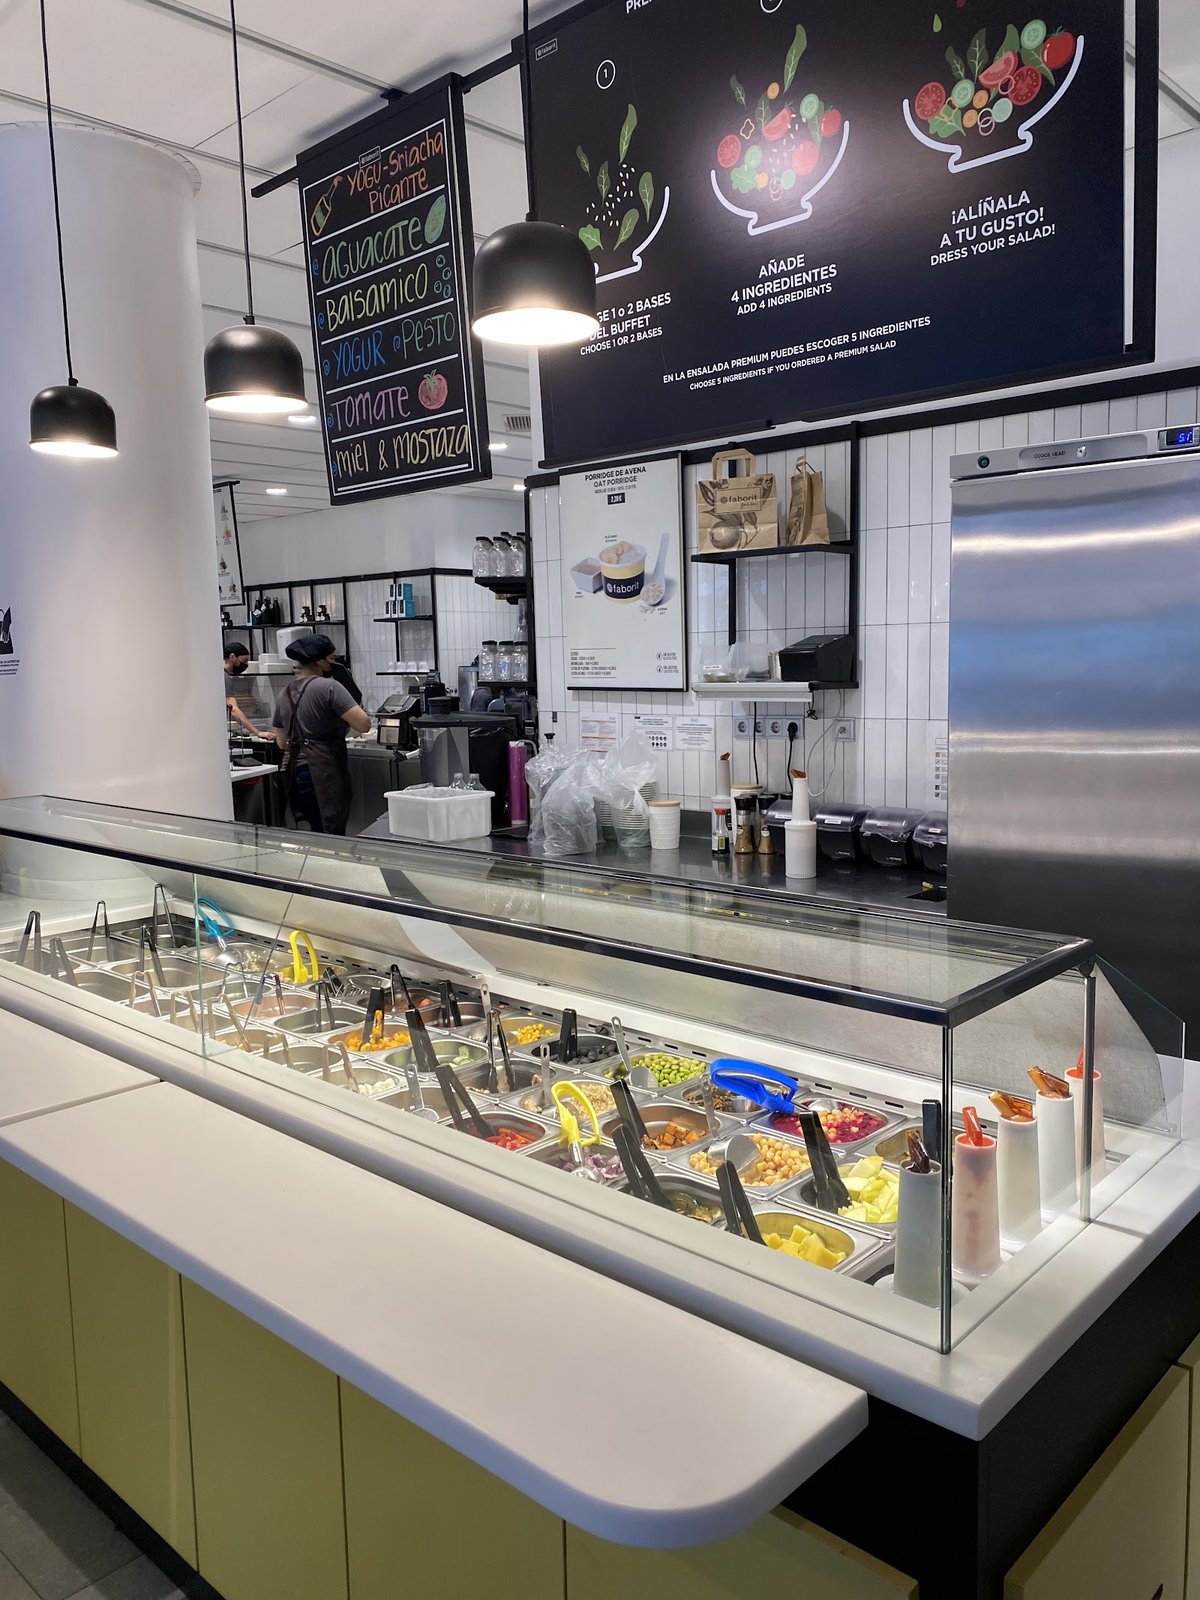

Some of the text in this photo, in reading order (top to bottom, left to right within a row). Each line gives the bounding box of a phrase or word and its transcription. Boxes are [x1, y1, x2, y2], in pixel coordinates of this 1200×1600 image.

[603, 68, 608, 78] 1
[951, 190, 1031, 225] ¡ALÍÑALA
[939, 206, 1044, 248] A TU GUSTO!
[930, 223, 1056, 266] DRESS YOUR SALAD!
[758, 253, 805, 278] AÑADE
[730, 264, 837, 303] 4 INGREDIENTES
[611, 307, 616, 319] 1
[627, 303, 634, 315] 2
[636, 292, 672, 312] BASES
[736, 282, 833, 316] ADD 4 INGREDIENTS
[610, 314, 651, 336] BUFFET
[332, 331, 386, 380] YOGUR
[580, 326, 663, 355] CHOOSE 1 OR 2 BASES
[663, 316, 931, 384] EN LA ENSALADA PREMIUM PUEDES ESCOGER 5 INGREDIENTES
[689, 340, 897, 391] CHOOSE 5 INGREDIENTS IF YOU ORDERED A PREMIUM SALAD
[379, 439, 389, 471] &
[585, 466, 647, 481] PORRIDGE DE AVENA
[593, 475, 638, 488] OAT PORRIDGE
[728, 494, 757, 503] faborit
[613, 581, 640, 594] faborit
